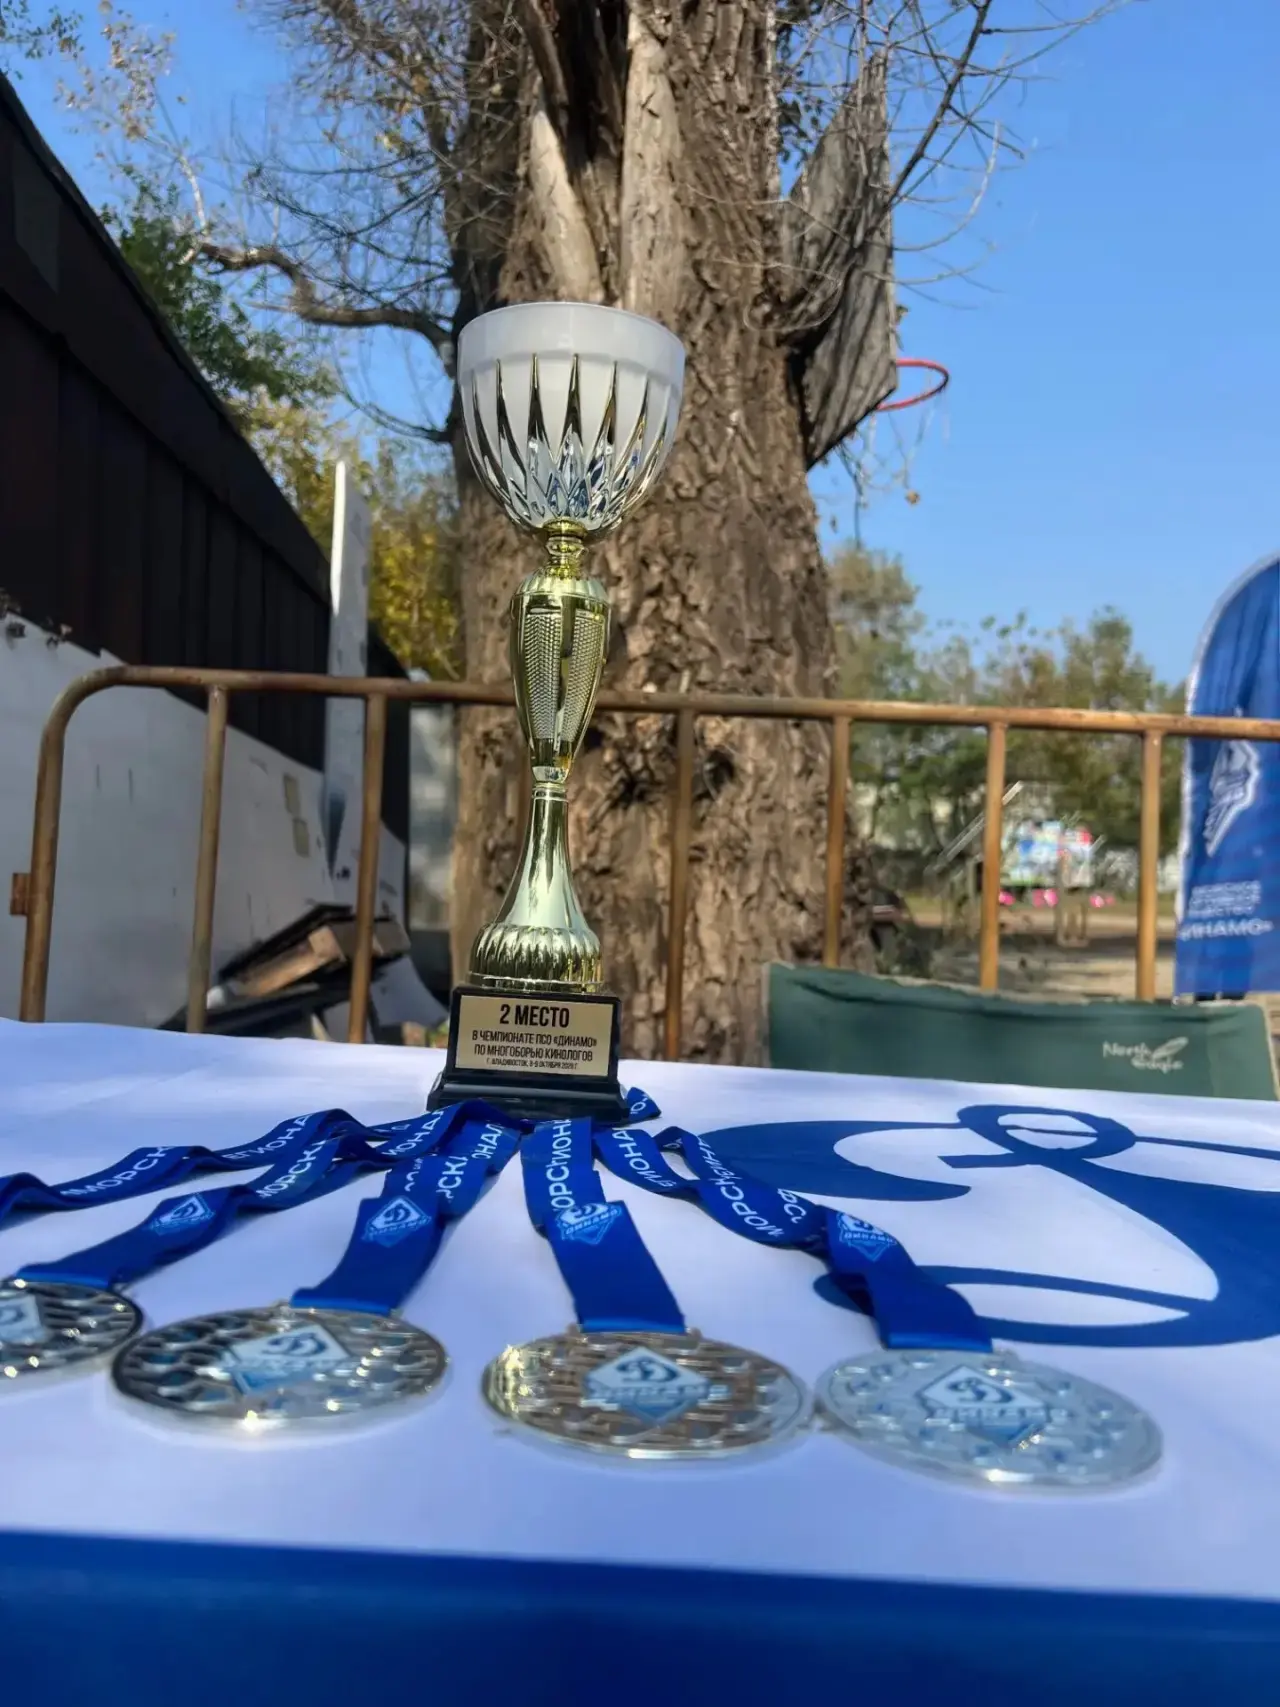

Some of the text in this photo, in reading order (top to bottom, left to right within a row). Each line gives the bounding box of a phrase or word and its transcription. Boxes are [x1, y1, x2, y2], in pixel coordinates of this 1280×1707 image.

[499, 1004, 570, 1028] 2 МЕСТО
[472, 1030, 478, 1041] В
[480, 1031, 534, 1044] ЧЕМПИОНАТЕ
[474, 1044, 593, 1062] ПО МНОГОБОРЬЮ КИНОЛОГОВ
